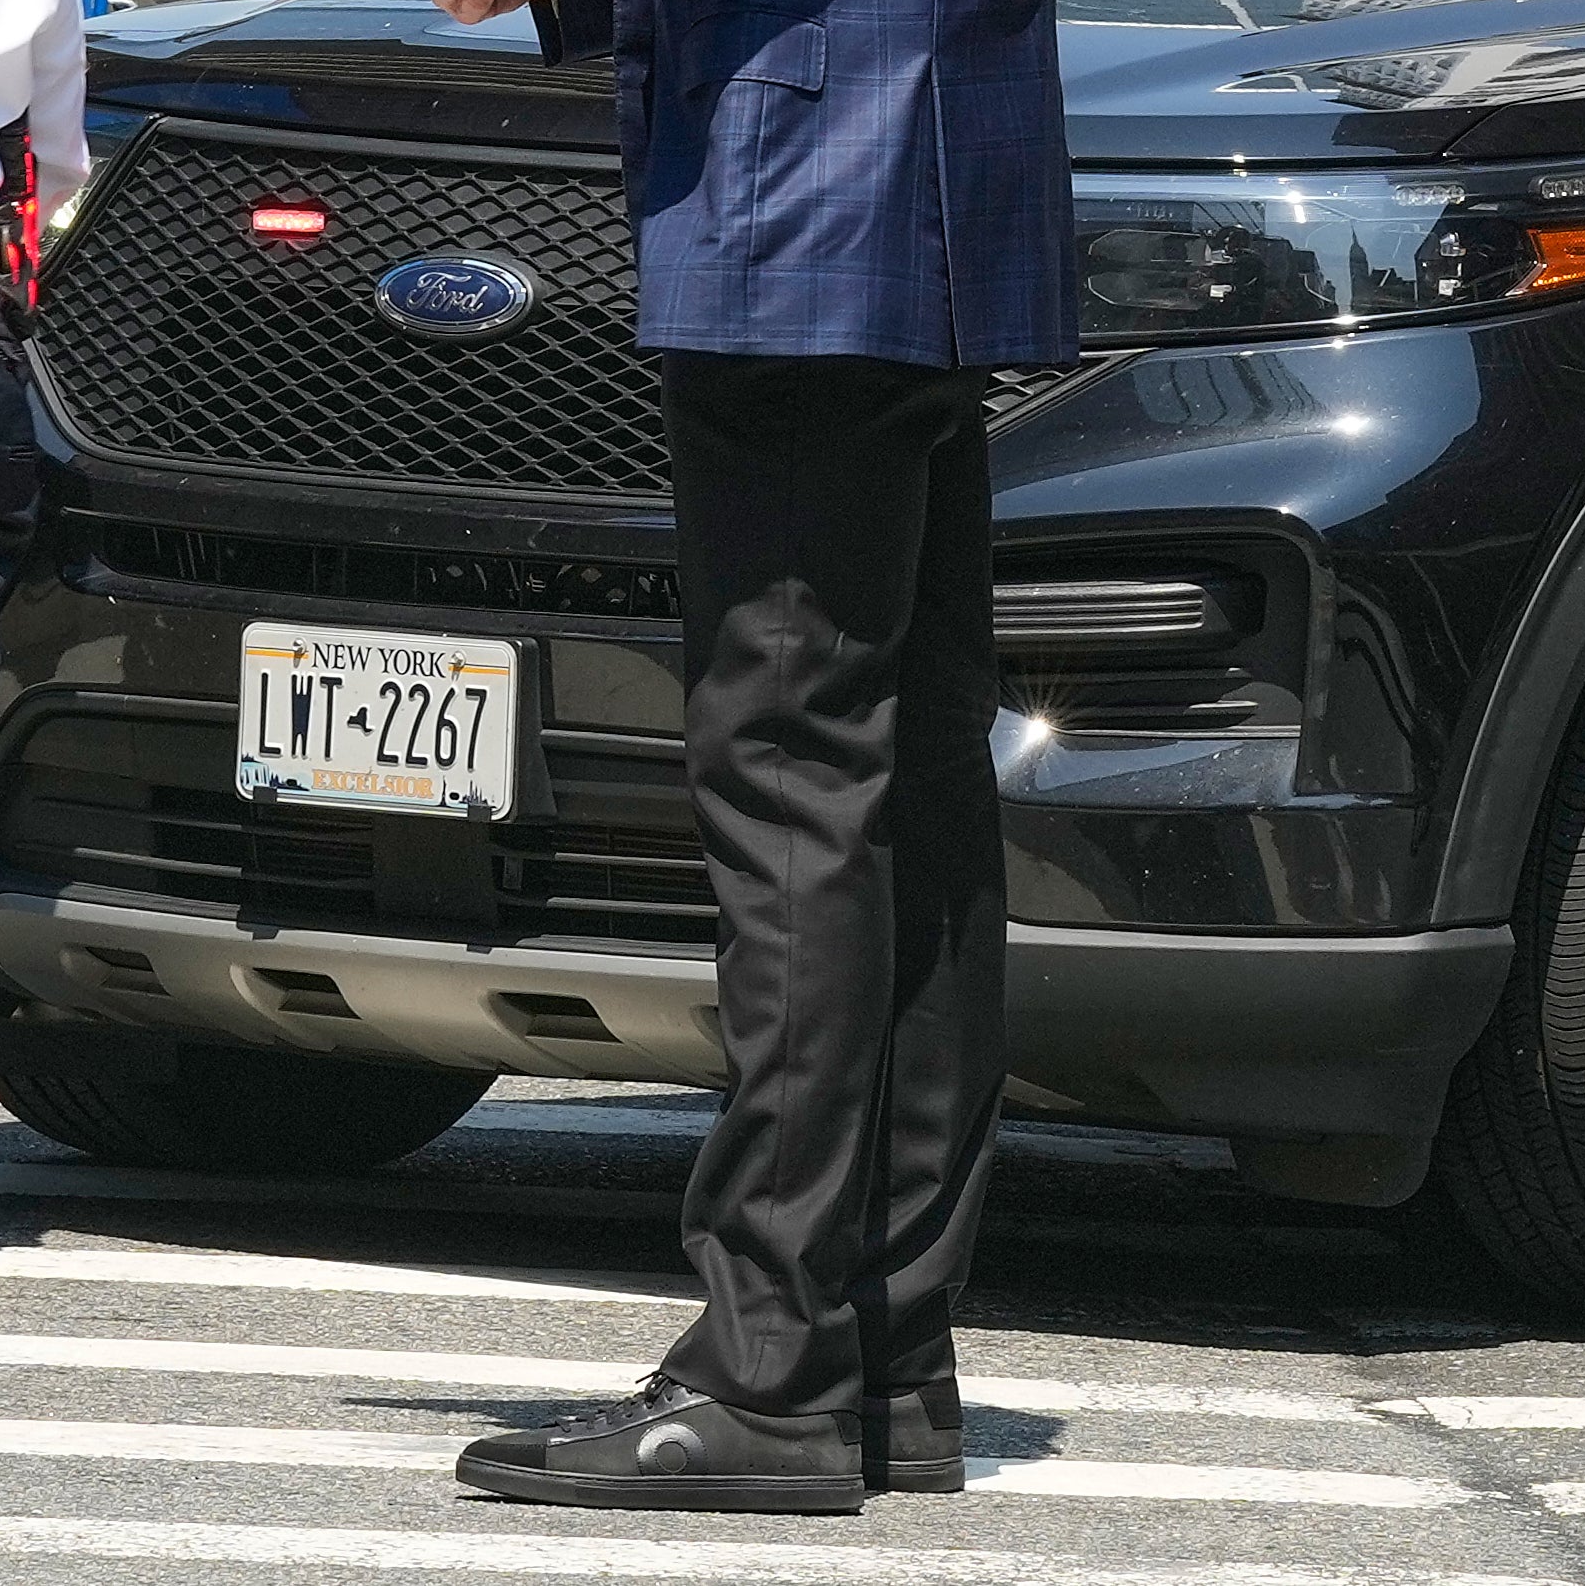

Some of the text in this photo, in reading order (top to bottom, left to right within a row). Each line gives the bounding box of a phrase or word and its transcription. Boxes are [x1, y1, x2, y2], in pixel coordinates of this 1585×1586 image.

[408, 272, 490, 314] Ford
[311, 642, 447, 679] NEW YORK
[259, 671, 488, 773] LWT 2267
[312, 768, 435, 799] EXCELSIOR
